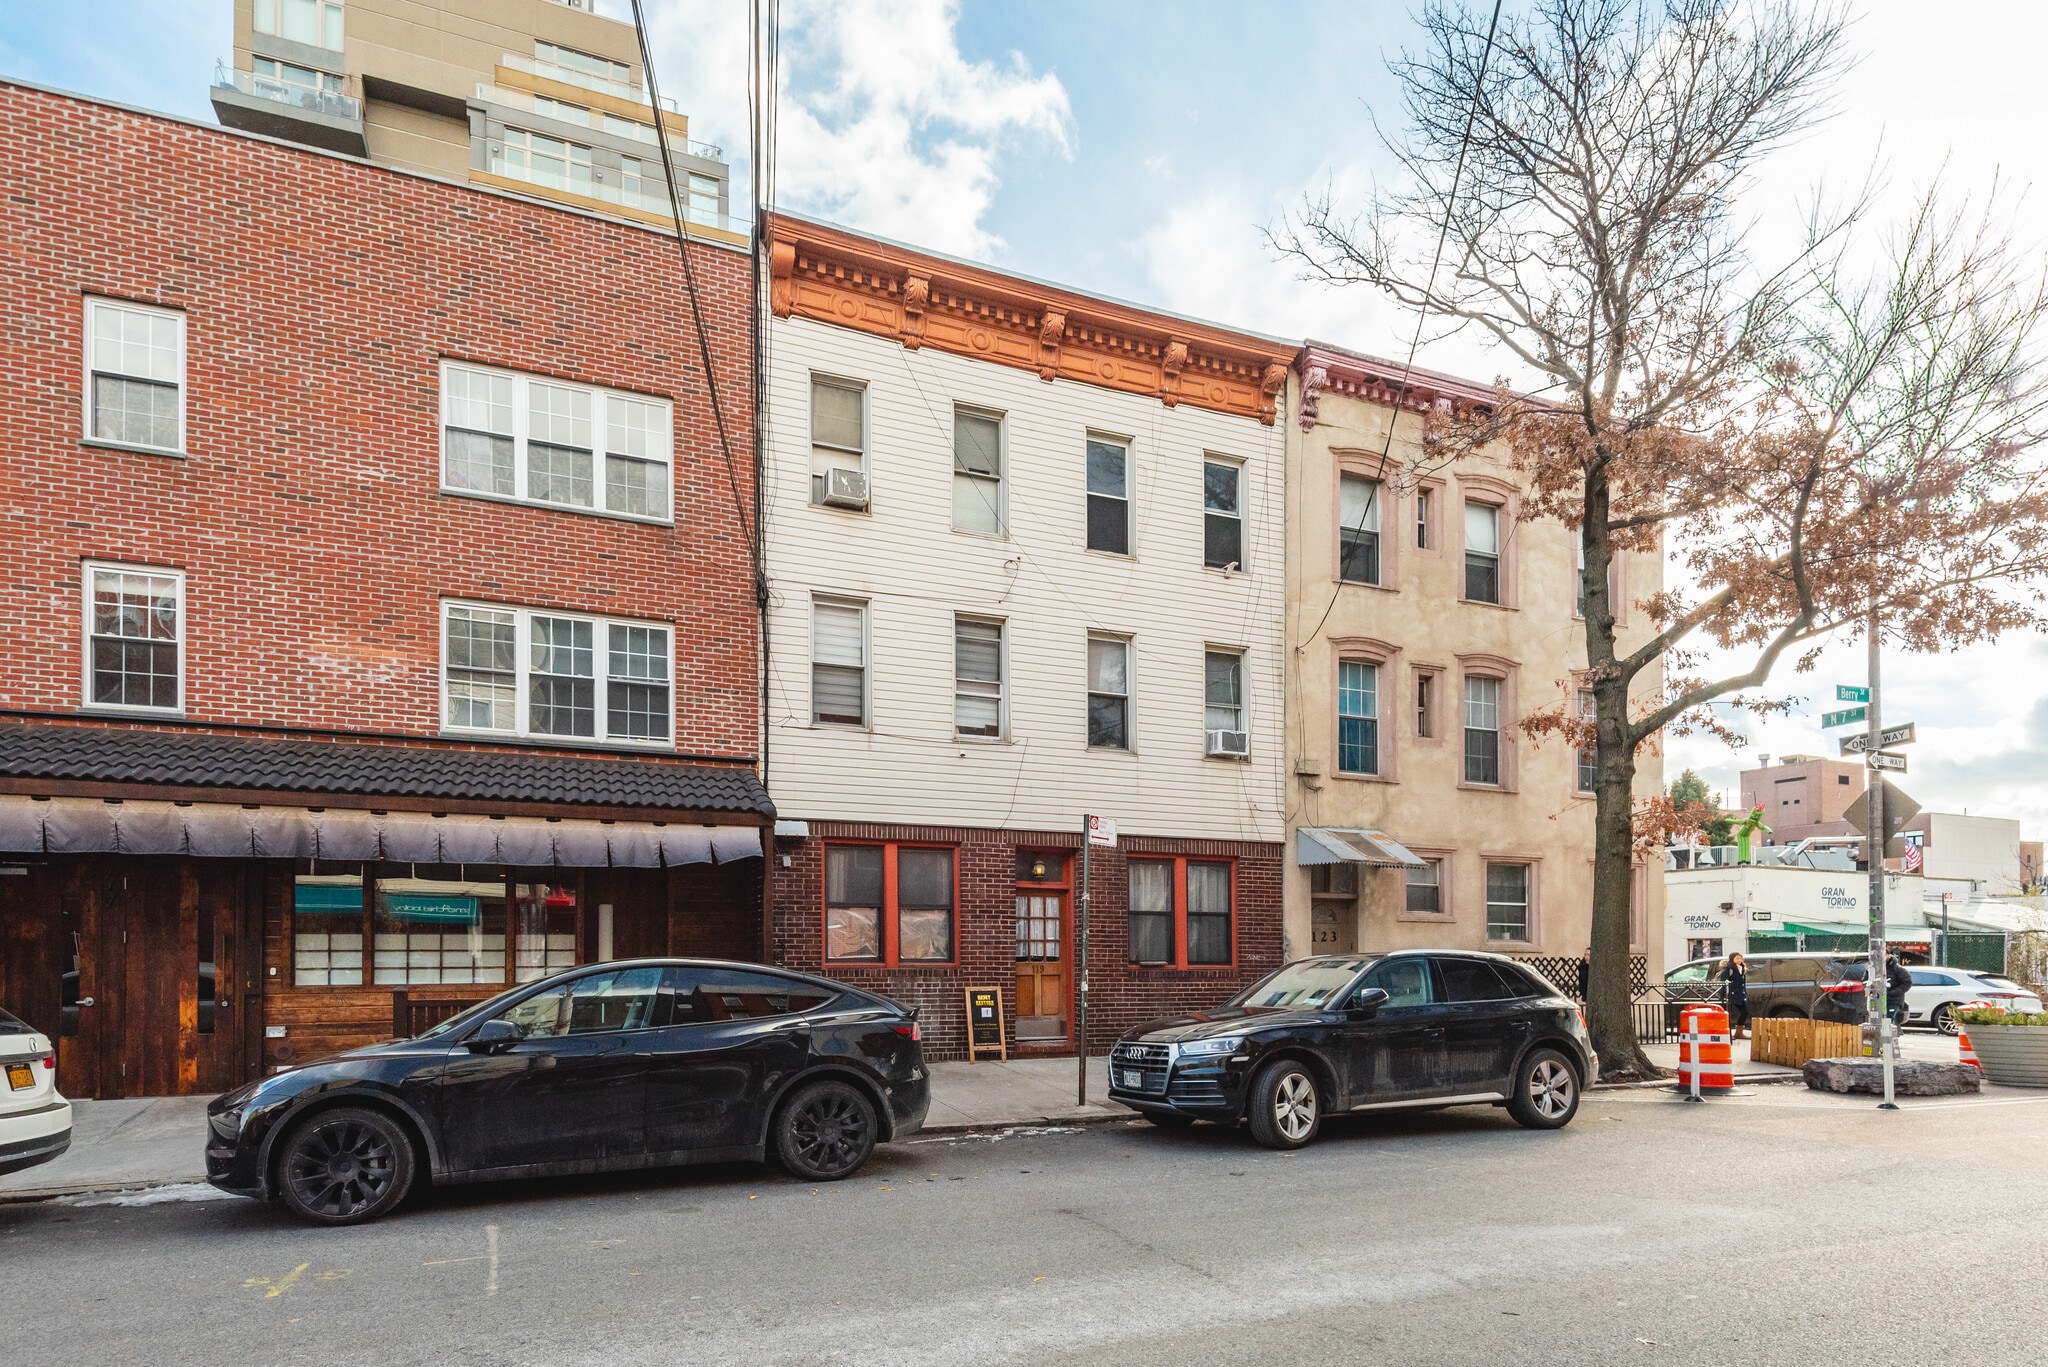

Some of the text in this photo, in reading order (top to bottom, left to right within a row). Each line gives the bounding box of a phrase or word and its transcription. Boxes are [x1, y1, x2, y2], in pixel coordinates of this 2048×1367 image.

[1840, 687, 1858, 700] Berry
[1830, 713, 1837, 726] N
[1841, 711, 1847, 723] 7
[1852, 730, 1905, 749] ON WAY
[1872, 755, 1902, 767] ONE WAY
[1821, 886, 1845, 897] GRAN
[1821, 896, 1857, 907] TORINO
[1684, 915, 1709, 923] GRAN
[1684, 921, 1721, 929] TORINO
[1312, 931, 1337, 943] 123
[1032, 964, 1045, 974] 119
